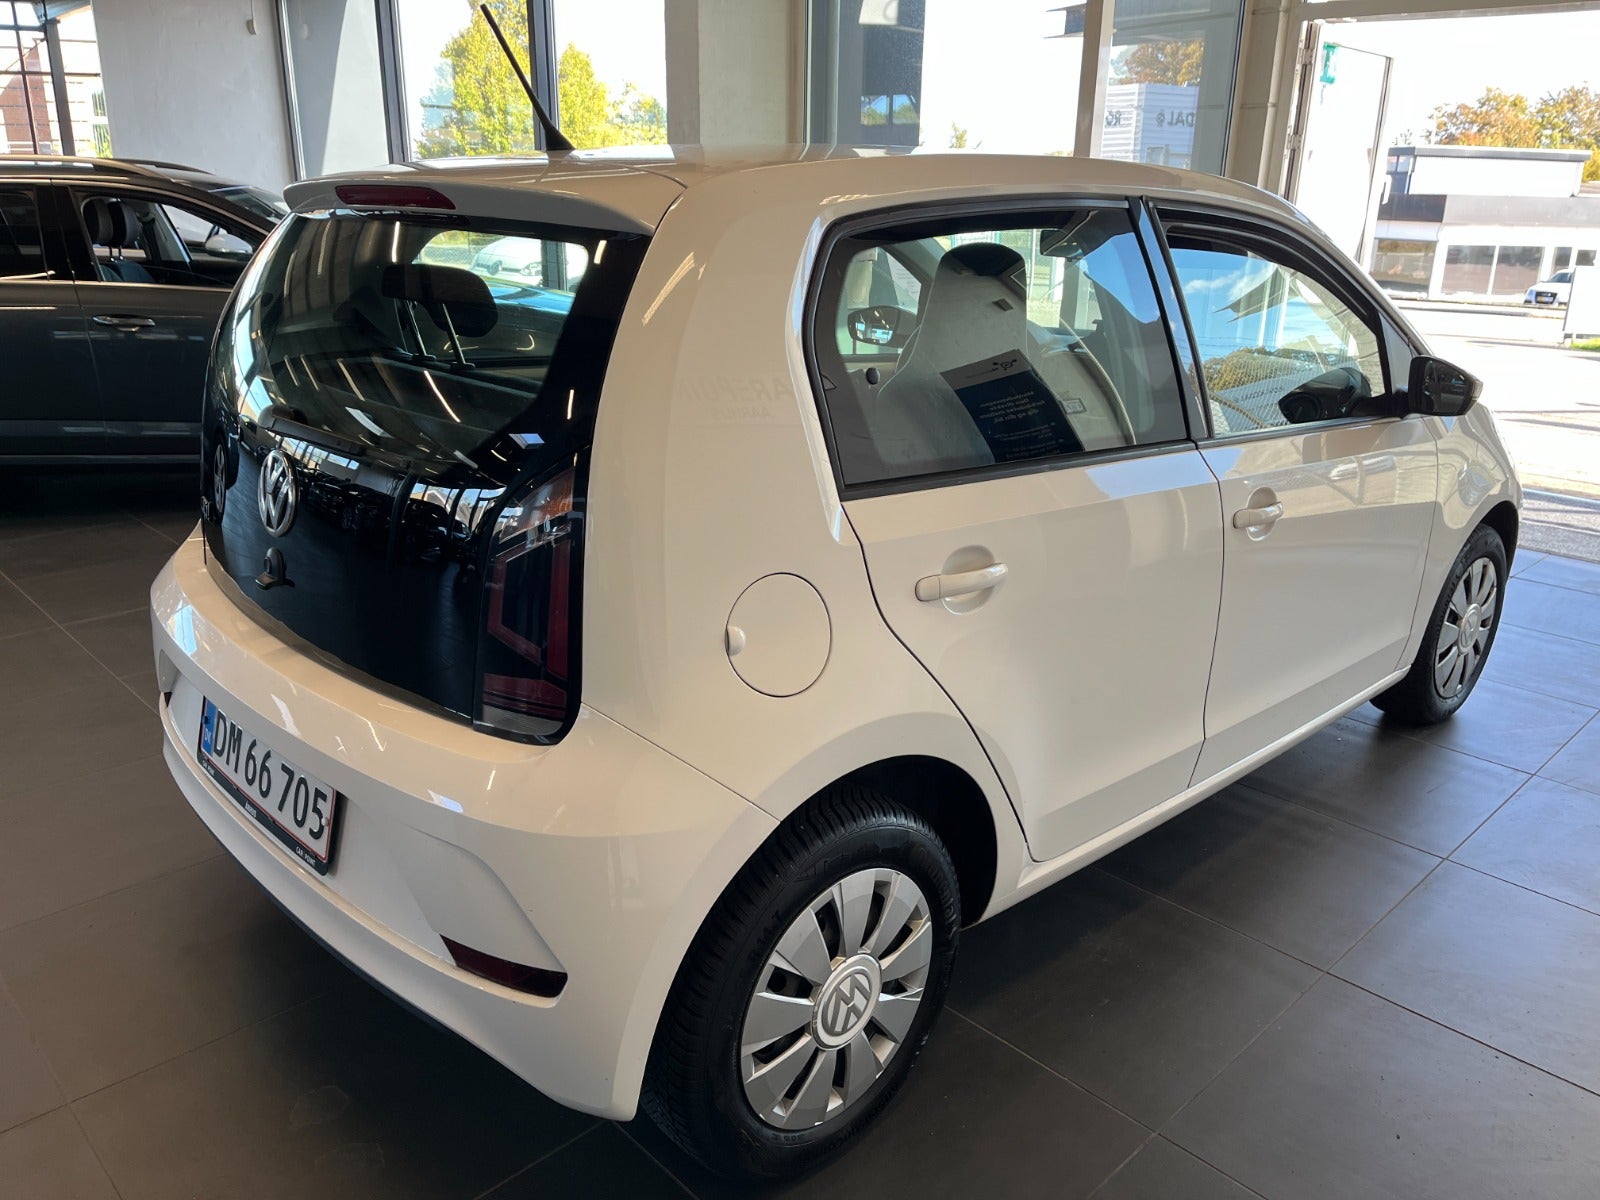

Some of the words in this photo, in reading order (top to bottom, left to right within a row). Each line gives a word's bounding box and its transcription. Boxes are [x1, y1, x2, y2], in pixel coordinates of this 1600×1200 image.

[213, 710, 243, 775] DM
[244, 738, 272, 799] 66
[277, 761, 328, 841] 705
